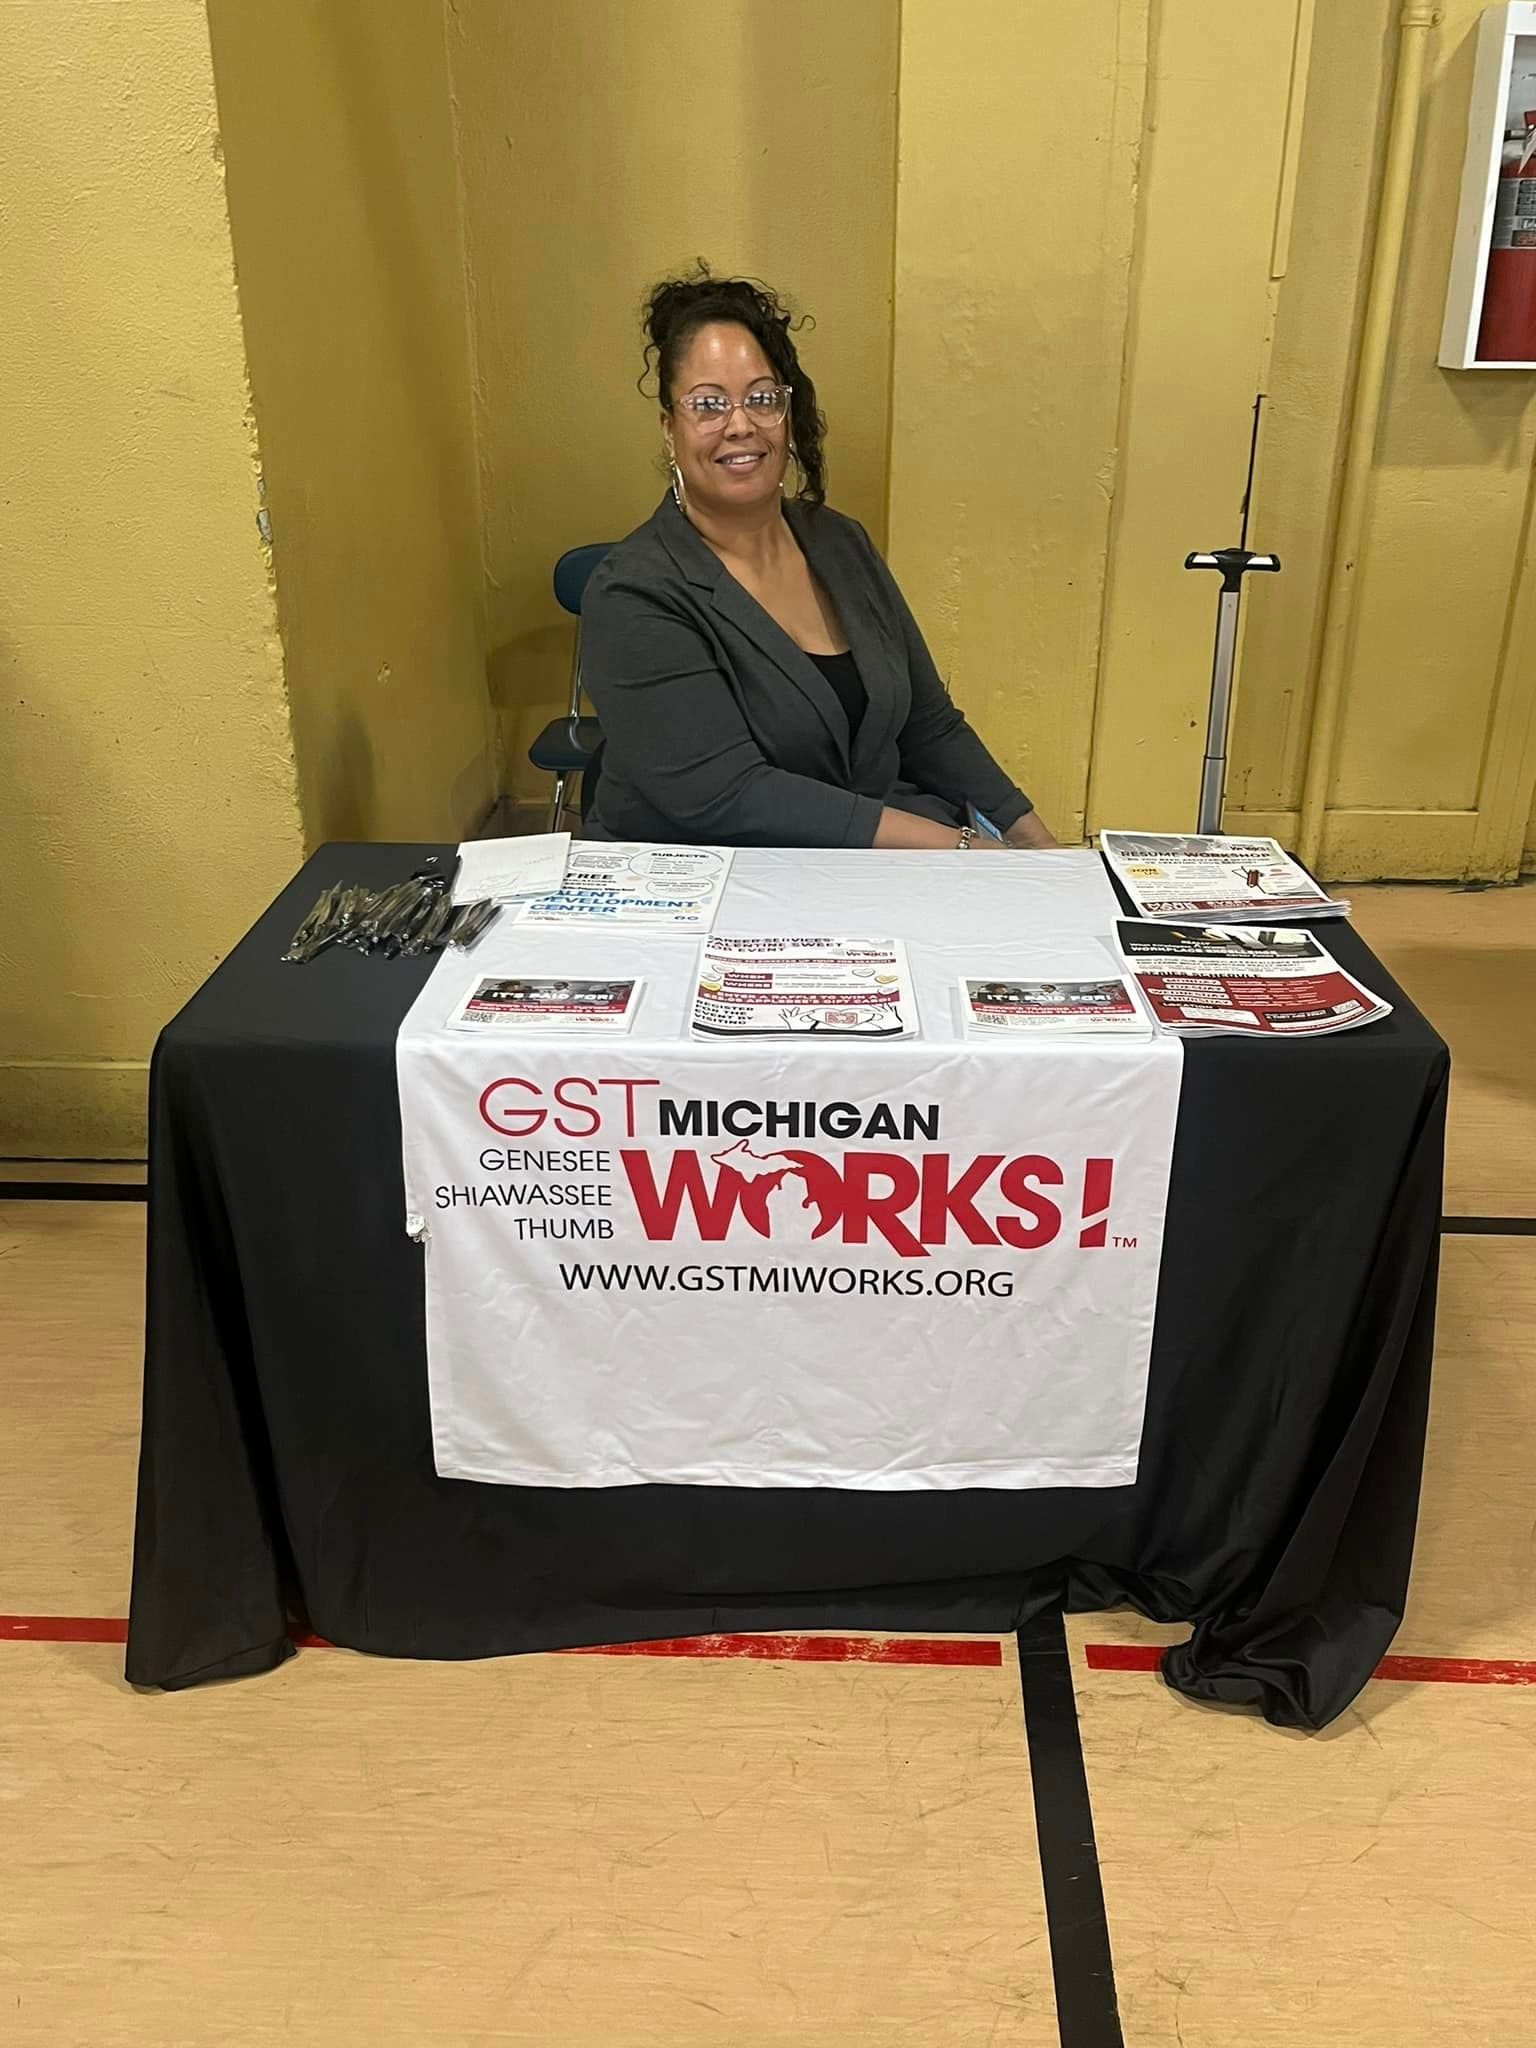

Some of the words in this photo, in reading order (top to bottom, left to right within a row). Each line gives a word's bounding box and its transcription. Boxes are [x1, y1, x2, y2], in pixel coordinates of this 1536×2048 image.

[556, 890, 620, 898] ALENT
[530, 904, 617, 913] CENTER
[479, 1077, 660, 1137] GST
[659, 1100, 939, 1140] MICHIGAN
[480, 1149, 612, 1173] GENESEE
[435, 1184, 613, 1207] SHIAWASSEE
[620, 1148, 1114, 1257] WORKS!
[515, 1218, 615, 1239] THUMB
[559, 1263, 1014, 1298] WWW.GSTMIWORKS.ORG
